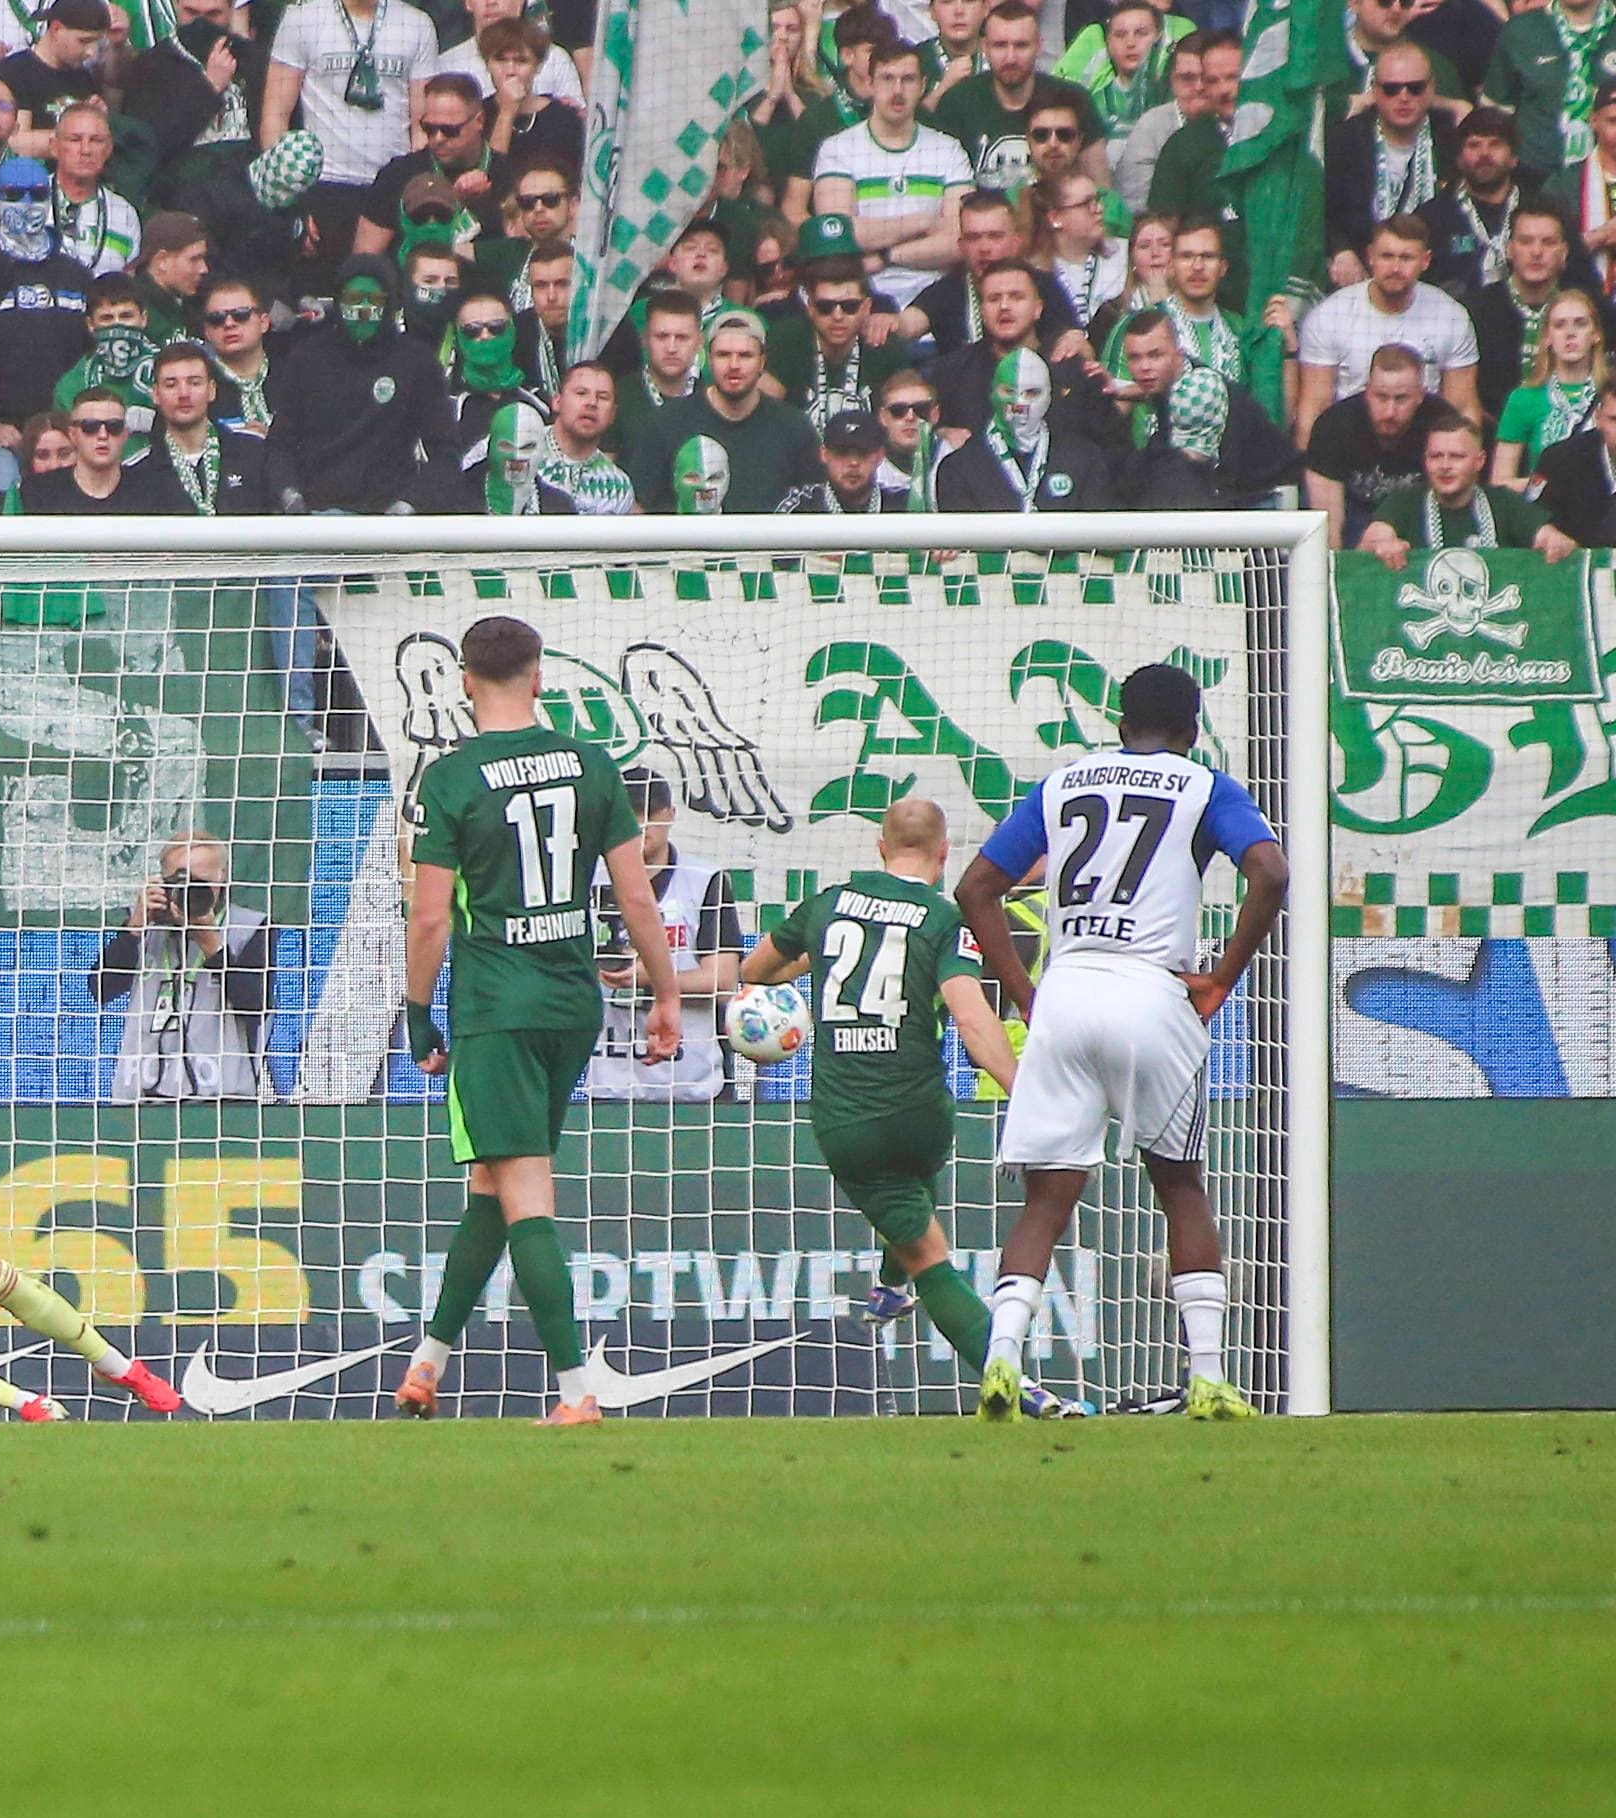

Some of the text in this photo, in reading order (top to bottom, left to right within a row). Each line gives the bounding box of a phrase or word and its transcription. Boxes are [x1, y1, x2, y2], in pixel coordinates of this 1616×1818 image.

[1371, 647, 1473, 684] Bernie
[1519, 660, 1573, 684] uns
[479, 750, 584, 791] WOLFSBURG
[1061, 766, 1192, 793] HAMBURGER SV
[503, 785, 581, 909] 17
[1058, 793, 1177, 908] 27
[834, 889, 930, 929] WOLFSBURG
[821, 919, 910, 1029] 24
[834, 1026, 899, 1053] ERIKSEN
